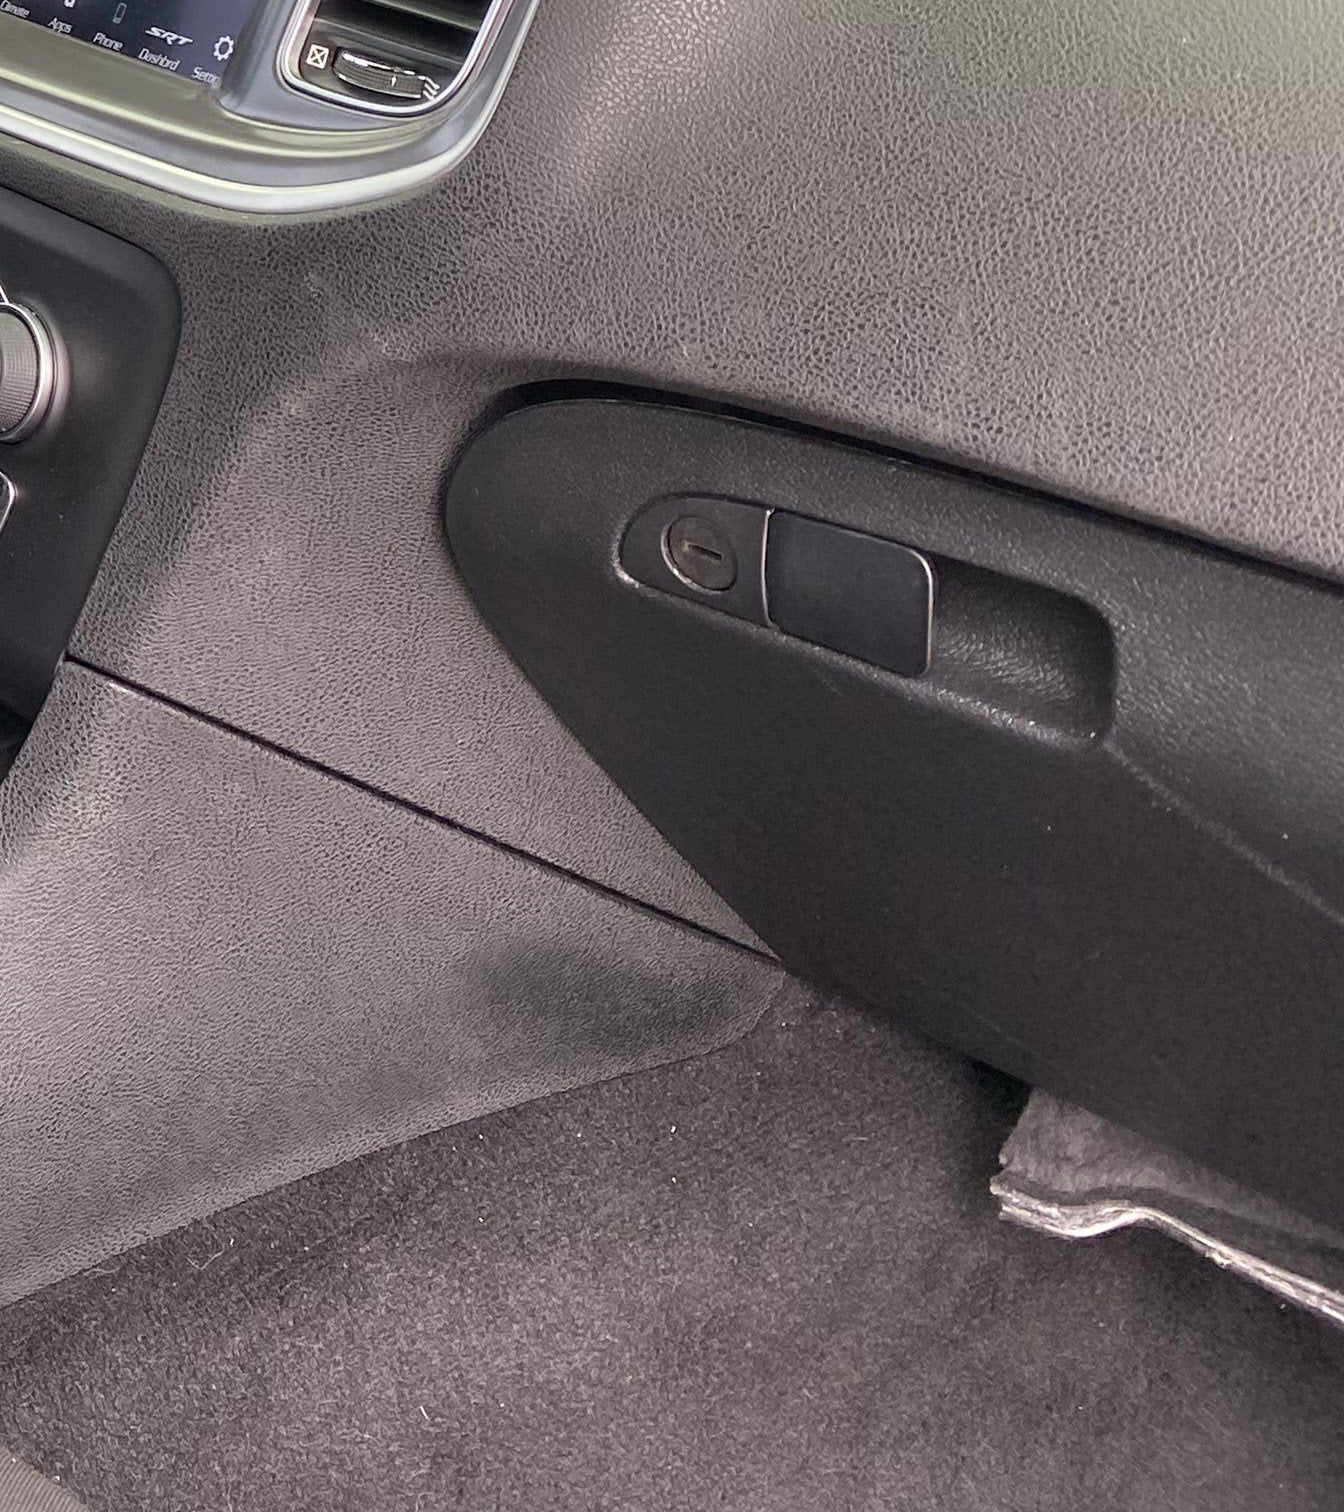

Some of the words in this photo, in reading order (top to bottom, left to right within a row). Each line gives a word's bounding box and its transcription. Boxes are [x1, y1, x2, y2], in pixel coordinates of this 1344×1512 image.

[0, 0, 30, 19] Climate
[48, 17, 73, 34] Apps
[145, 25, 194, 46] SRT
[92, 32, 124, 52] Phone
[138, 47, 180, 72] Dashbrd
